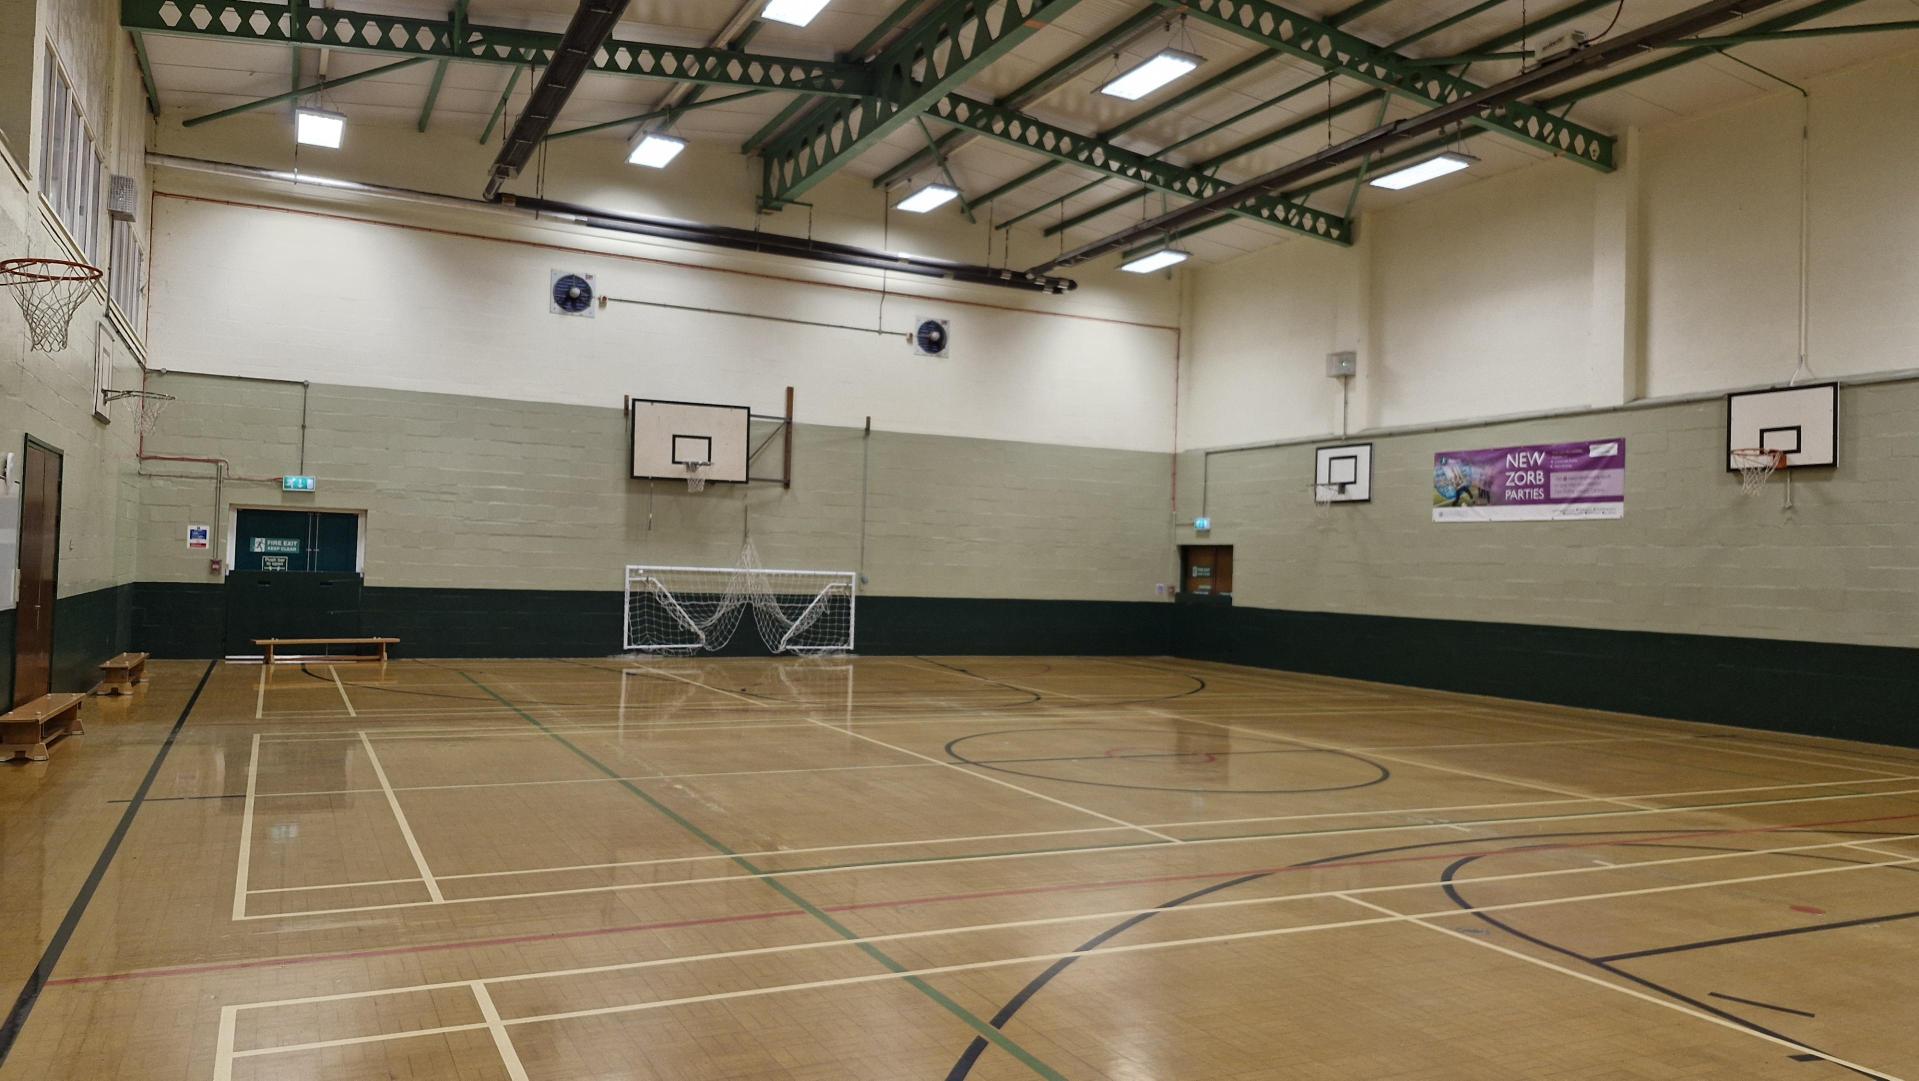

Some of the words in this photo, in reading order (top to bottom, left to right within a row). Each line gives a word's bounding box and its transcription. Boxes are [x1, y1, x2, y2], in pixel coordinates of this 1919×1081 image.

[1505, 451, 1545, 468] NEW
[1505, 470, 1544, 486] ZORB
[1505, 487, 1544, 500] PARTIES
